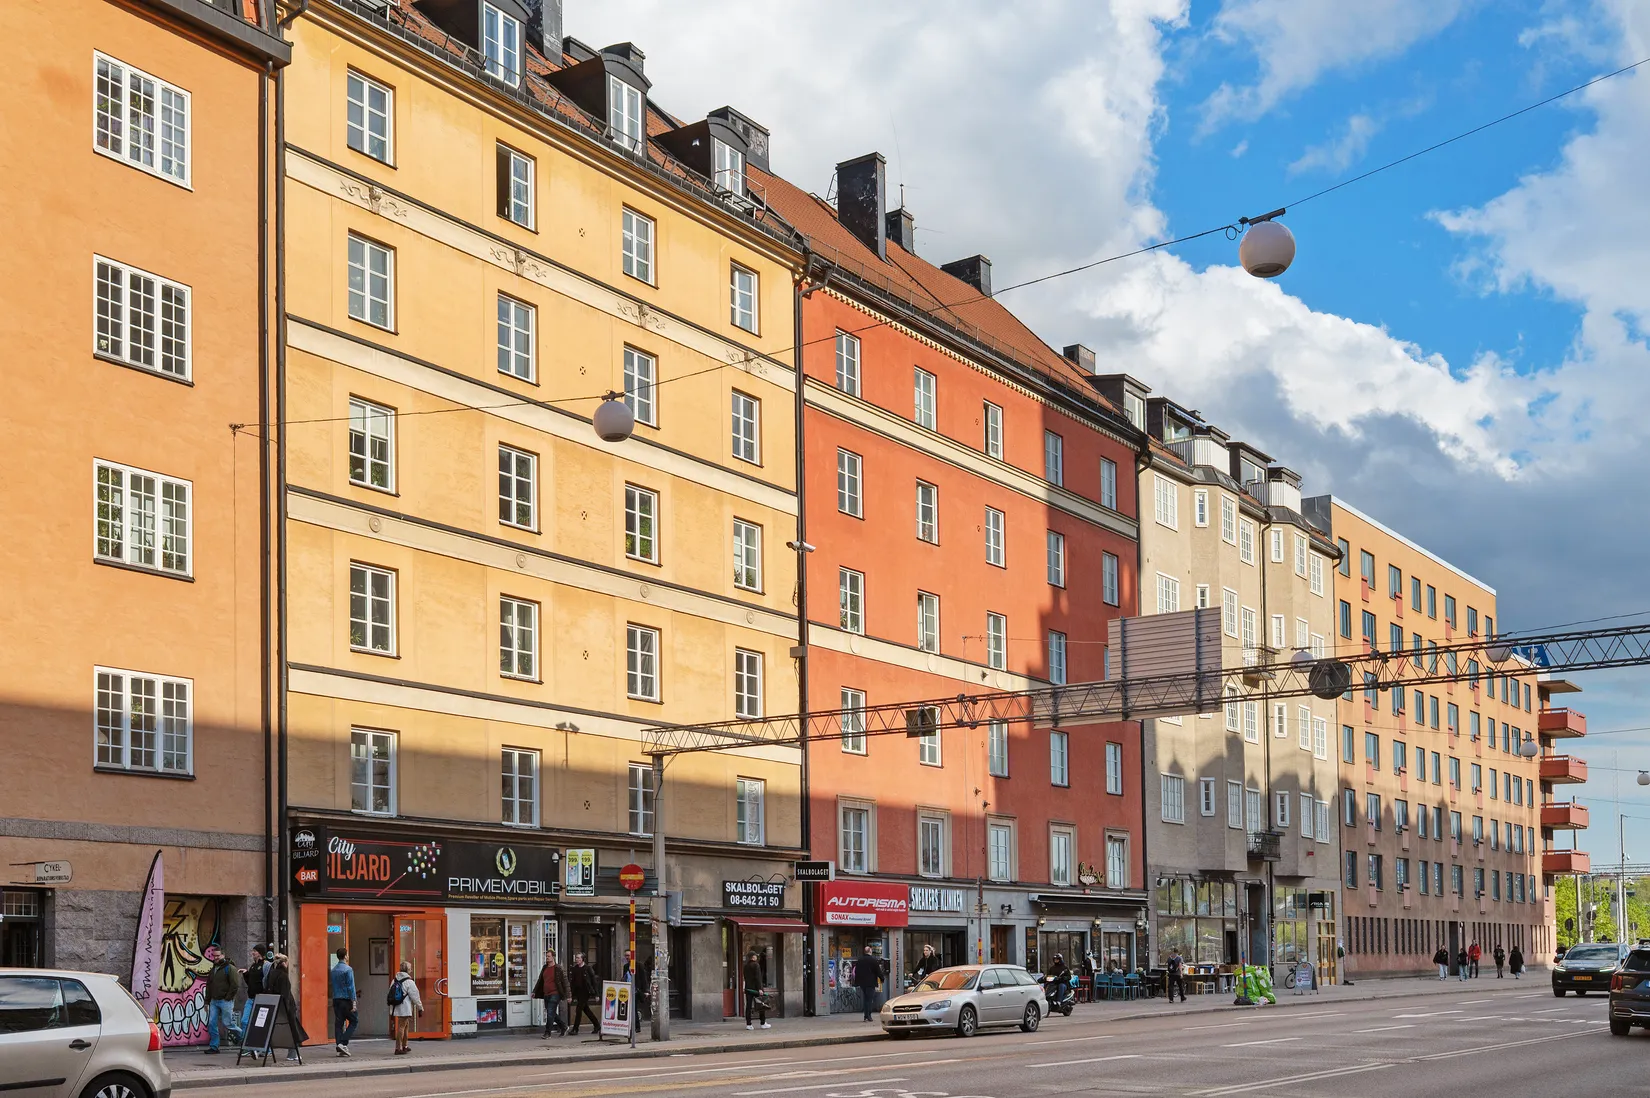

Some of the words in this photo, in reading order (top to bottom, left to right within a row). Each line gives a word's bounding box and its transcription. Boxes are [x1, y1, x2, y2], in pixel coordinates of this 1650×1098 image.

[292, 849, 319, 860] BILJARD
[328, 836, 356, 860] City
[300, 871, 317, 881] BAR
[797, 868, 829, 876] SKALBOLAGET
[448, 876, 560, 895] PRIMEMOBILE
[730, 894, 757, 905] 08-642
[758, 896, 767, 906] 21
[769, 896, 779, 907] 50
[827, 896, 906, 909] AUTORISMA
[911, 887, 938, 910] SNEAKERS
[831, 913, 849, 921] SONAX
